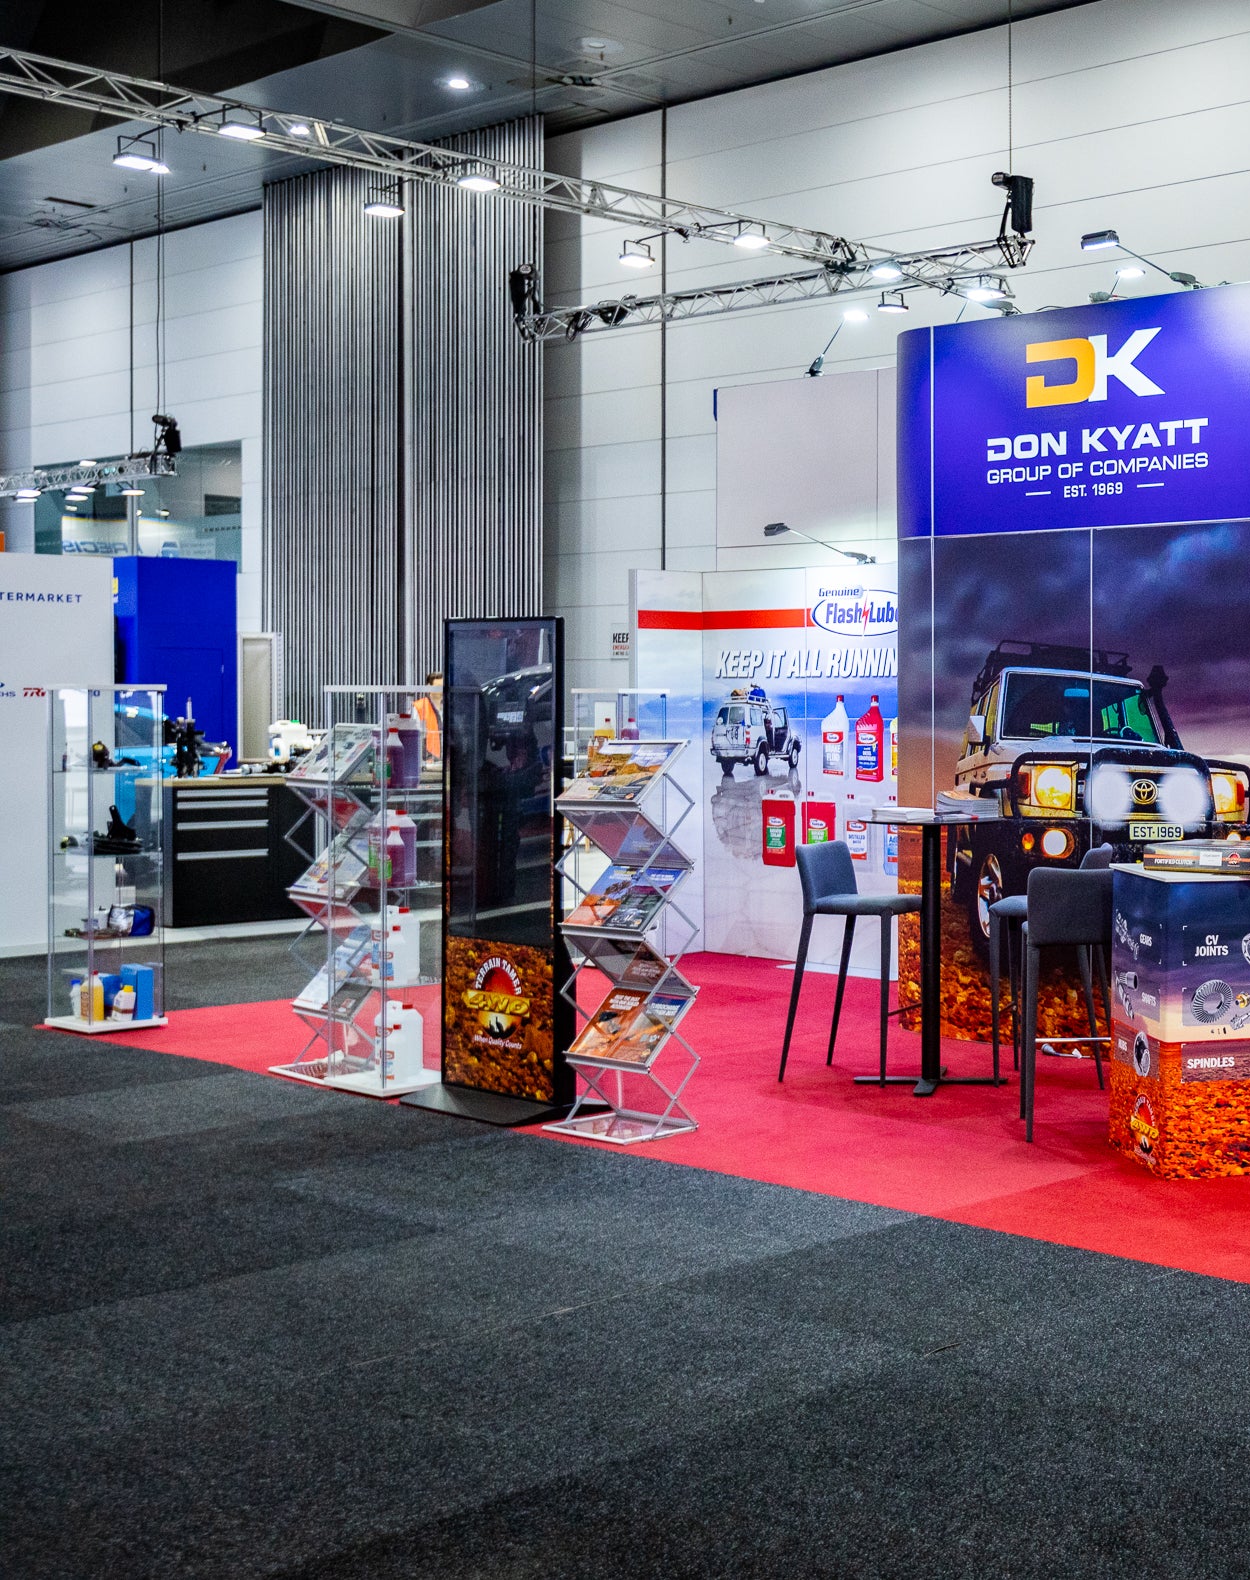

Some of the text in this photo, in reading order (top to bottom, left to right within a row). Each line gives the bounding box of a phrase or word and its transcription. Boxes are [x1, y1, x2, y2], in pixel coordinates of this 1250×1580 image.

[1026, 327, 1166, 409] DK
[987, 418, 1209, 462] DON KYATT
[987, 452, 1209, 485] GROUP OF COMPANIES
[1063, 482, 1123, 498] EST. 1969
[818, 587, 860, 598] Genuine
[715, 650, 764, 679] KEEP
[767, 649, 786, 679] IT
[786, 649, 823, 679] ALL
[1205, 934, 1219, 945] CV
[1194, 945, 1229, 957] JOINTS
[475, 957, 523, 996] TERRAIN TAMER
[474, 1033, 488, 1044] When
[1187, 1056, 1235, 1070] SPINDLES
